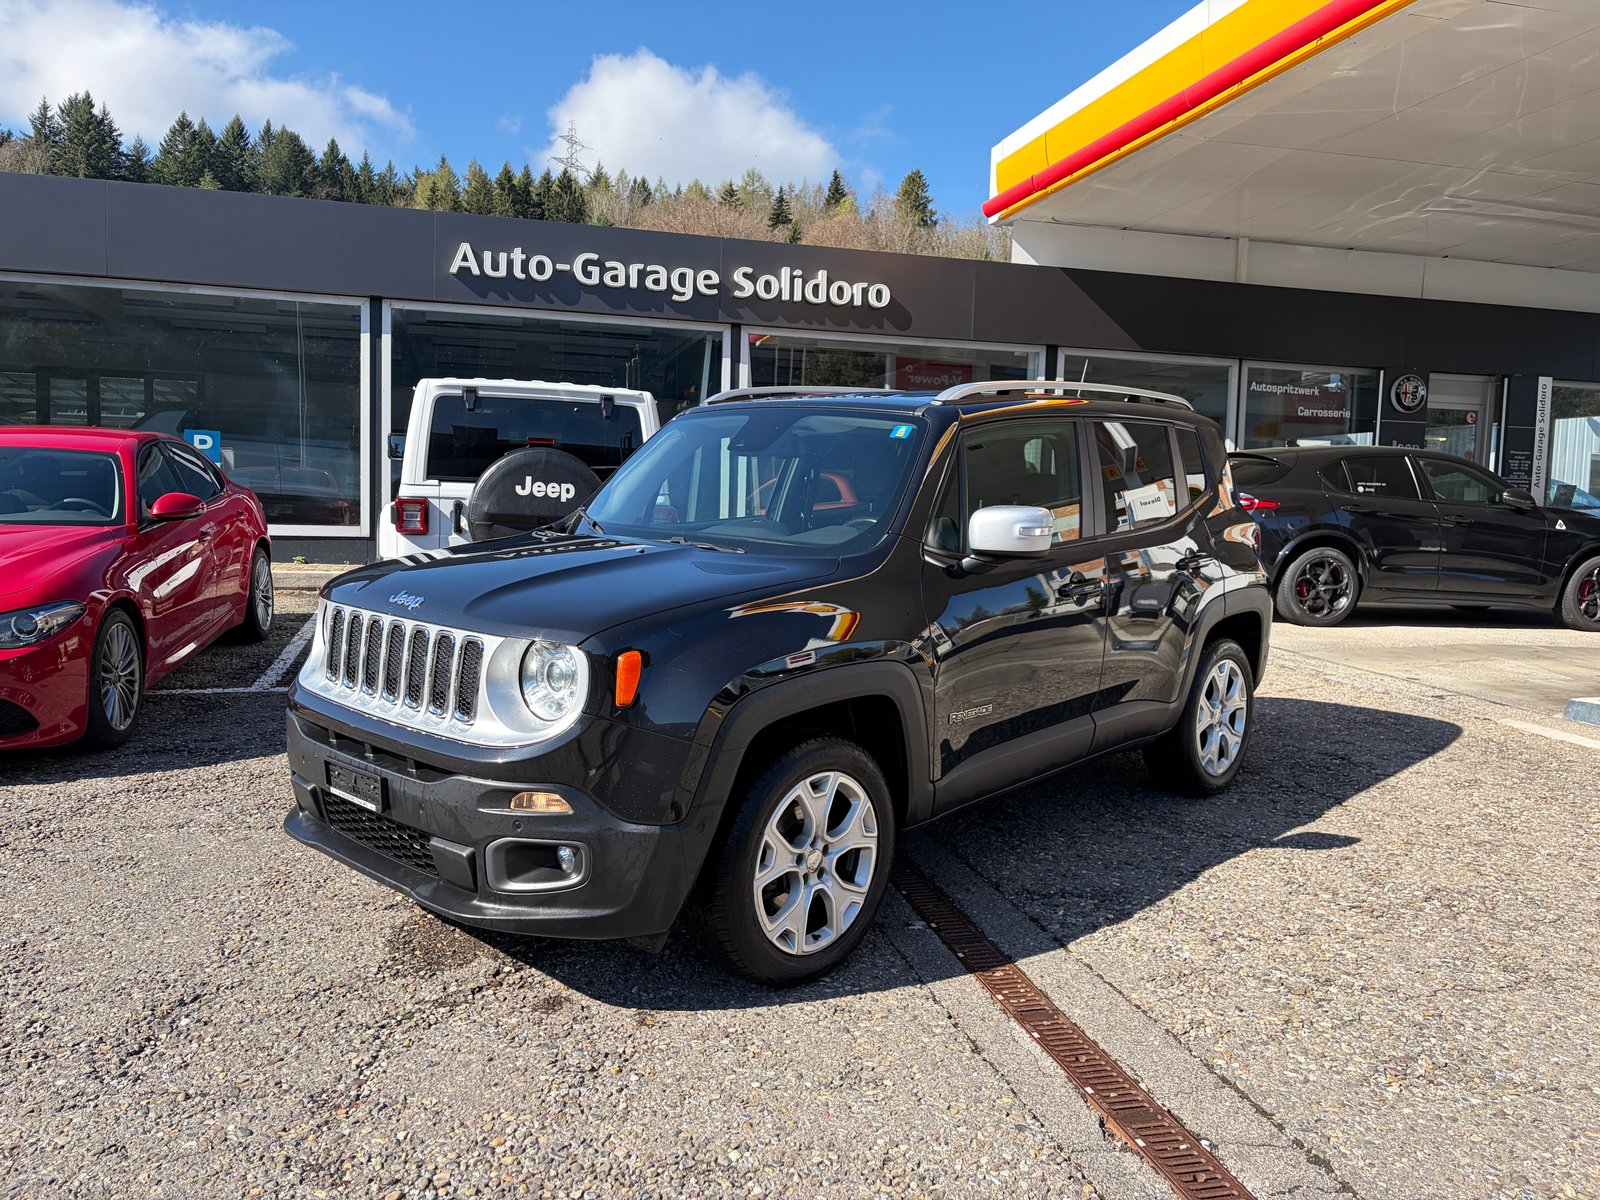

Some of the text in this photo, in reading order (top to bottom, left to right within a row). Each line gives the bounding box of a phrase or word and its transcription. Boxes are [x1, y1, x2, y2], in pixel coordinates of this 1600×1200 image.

[449, 242, 891, 309] Auto-Garage Solidoro
[1250, 381, 1320, 396] Autospritzwerk
[1297, 406, 1351, 418] Carrosserie
[193, 434, 213, 450] P
[1534, 383, 1548, 488] Auto-Garage Solidoro
[515, 475, 576, 502] Jeep
[389, 590, 425, 611] Jeep
